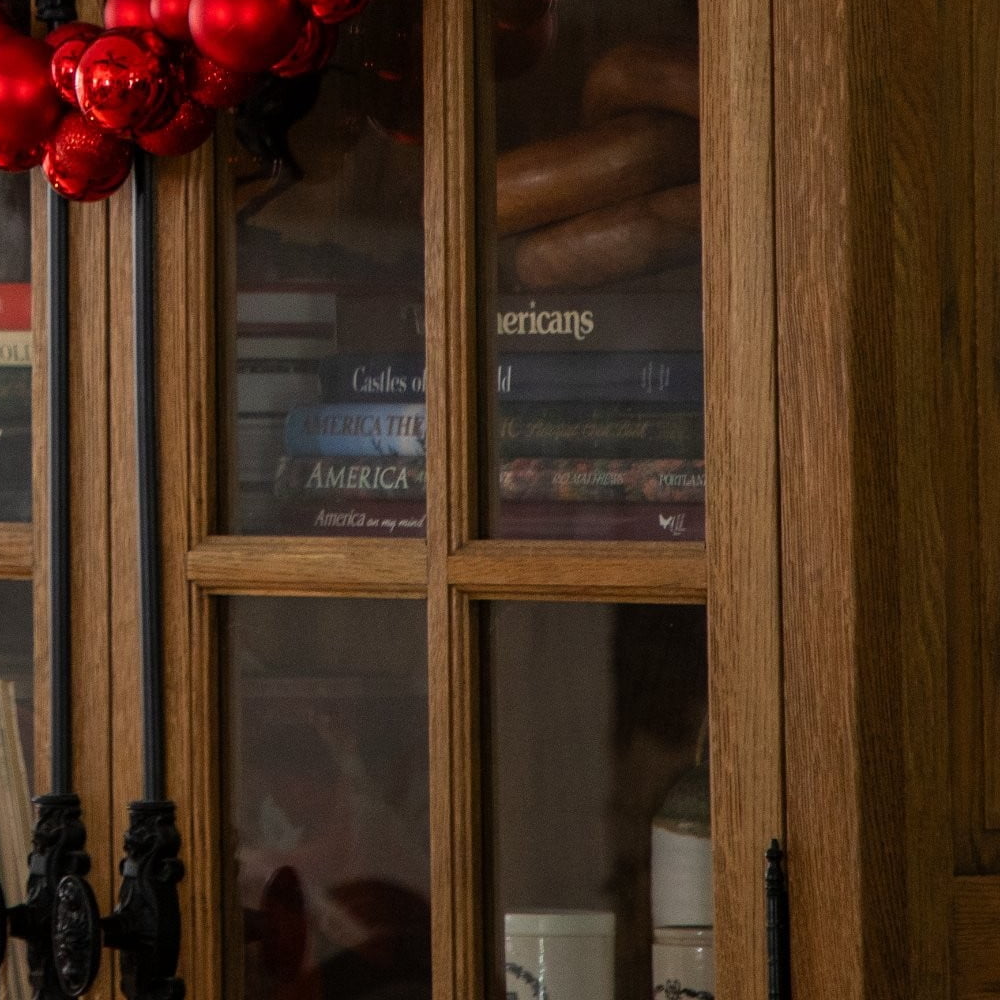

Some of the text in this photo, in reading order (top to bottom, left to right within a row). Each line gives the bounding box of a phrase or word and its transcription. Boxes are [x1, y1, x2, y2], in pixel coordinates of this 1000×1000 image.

[353, 366, 408, 393] Castles
[305, 461, 409, 489] AMERICA
[313, 508, 426, 533] America on my mind
